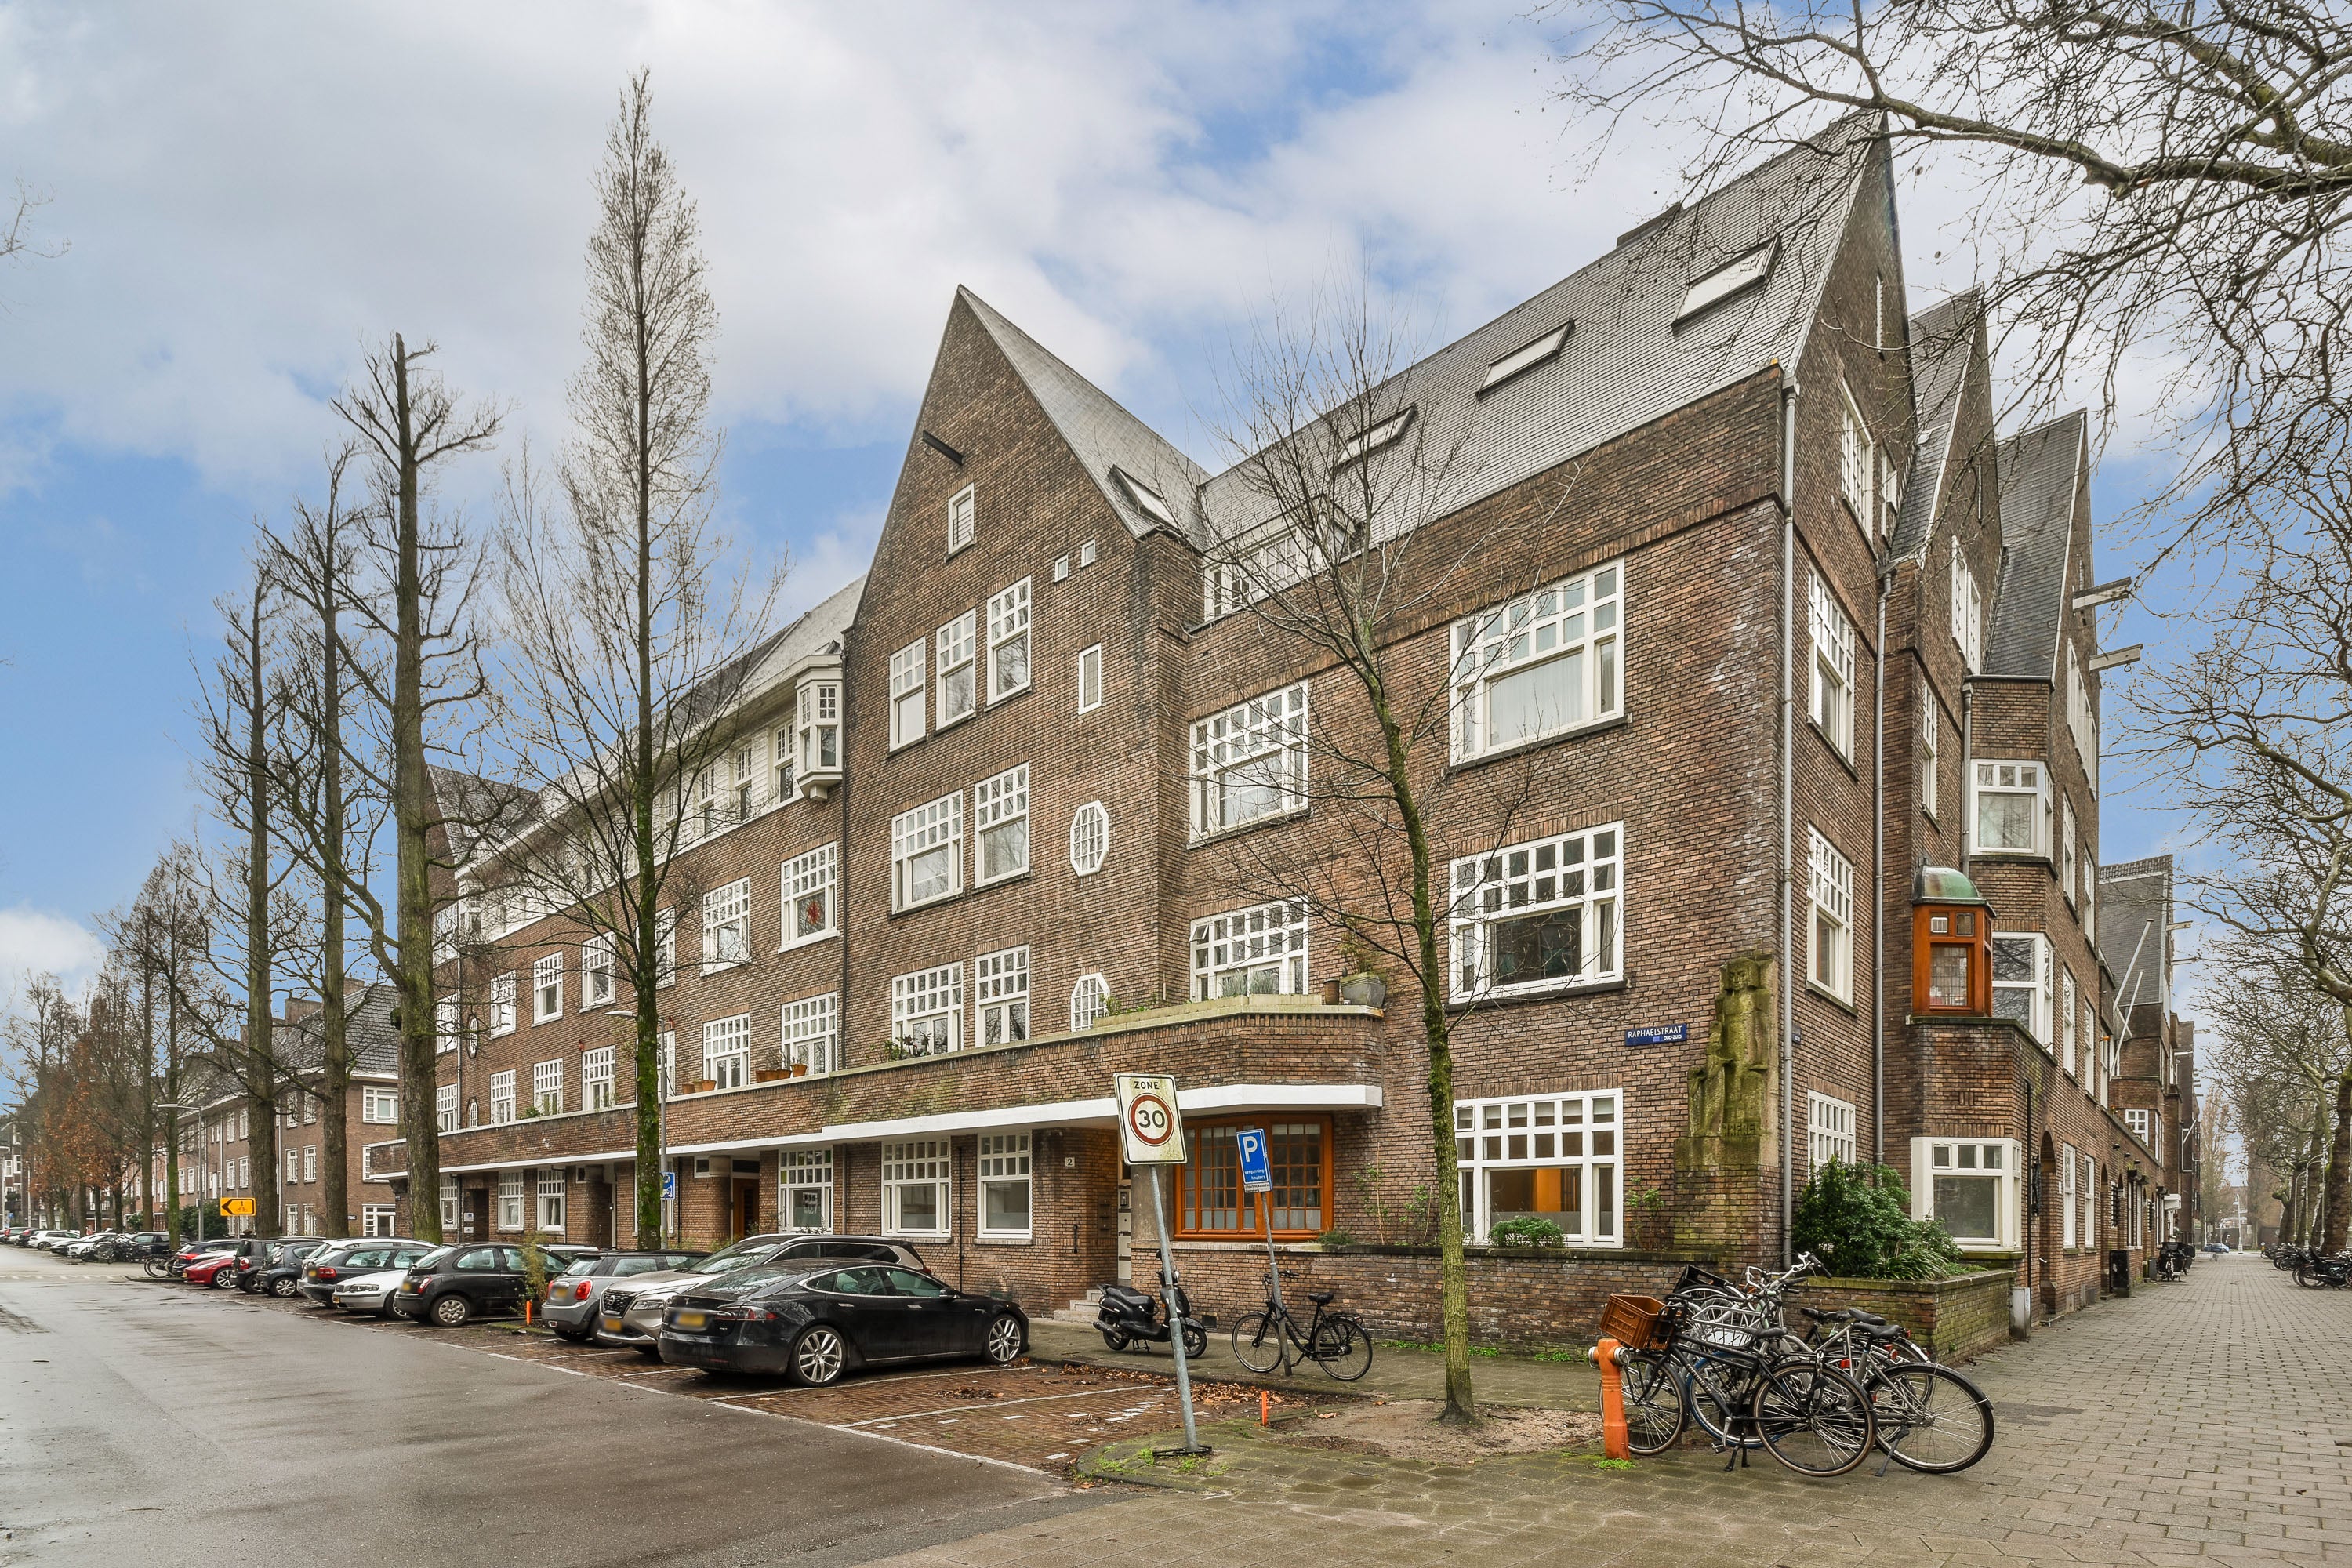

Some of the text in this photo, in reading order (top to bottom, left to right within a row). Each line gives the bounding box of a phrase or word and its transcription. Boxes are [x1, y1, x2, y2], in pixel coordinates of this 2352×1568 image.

[1628, 1025, 1682, 1039] RAPHAELSTRAAT
[1134, 1080, 1160, 1090] ZONE
[1138, 1109, 1165, 1128] 30
[1243, 1136, 1258, 1163] P
